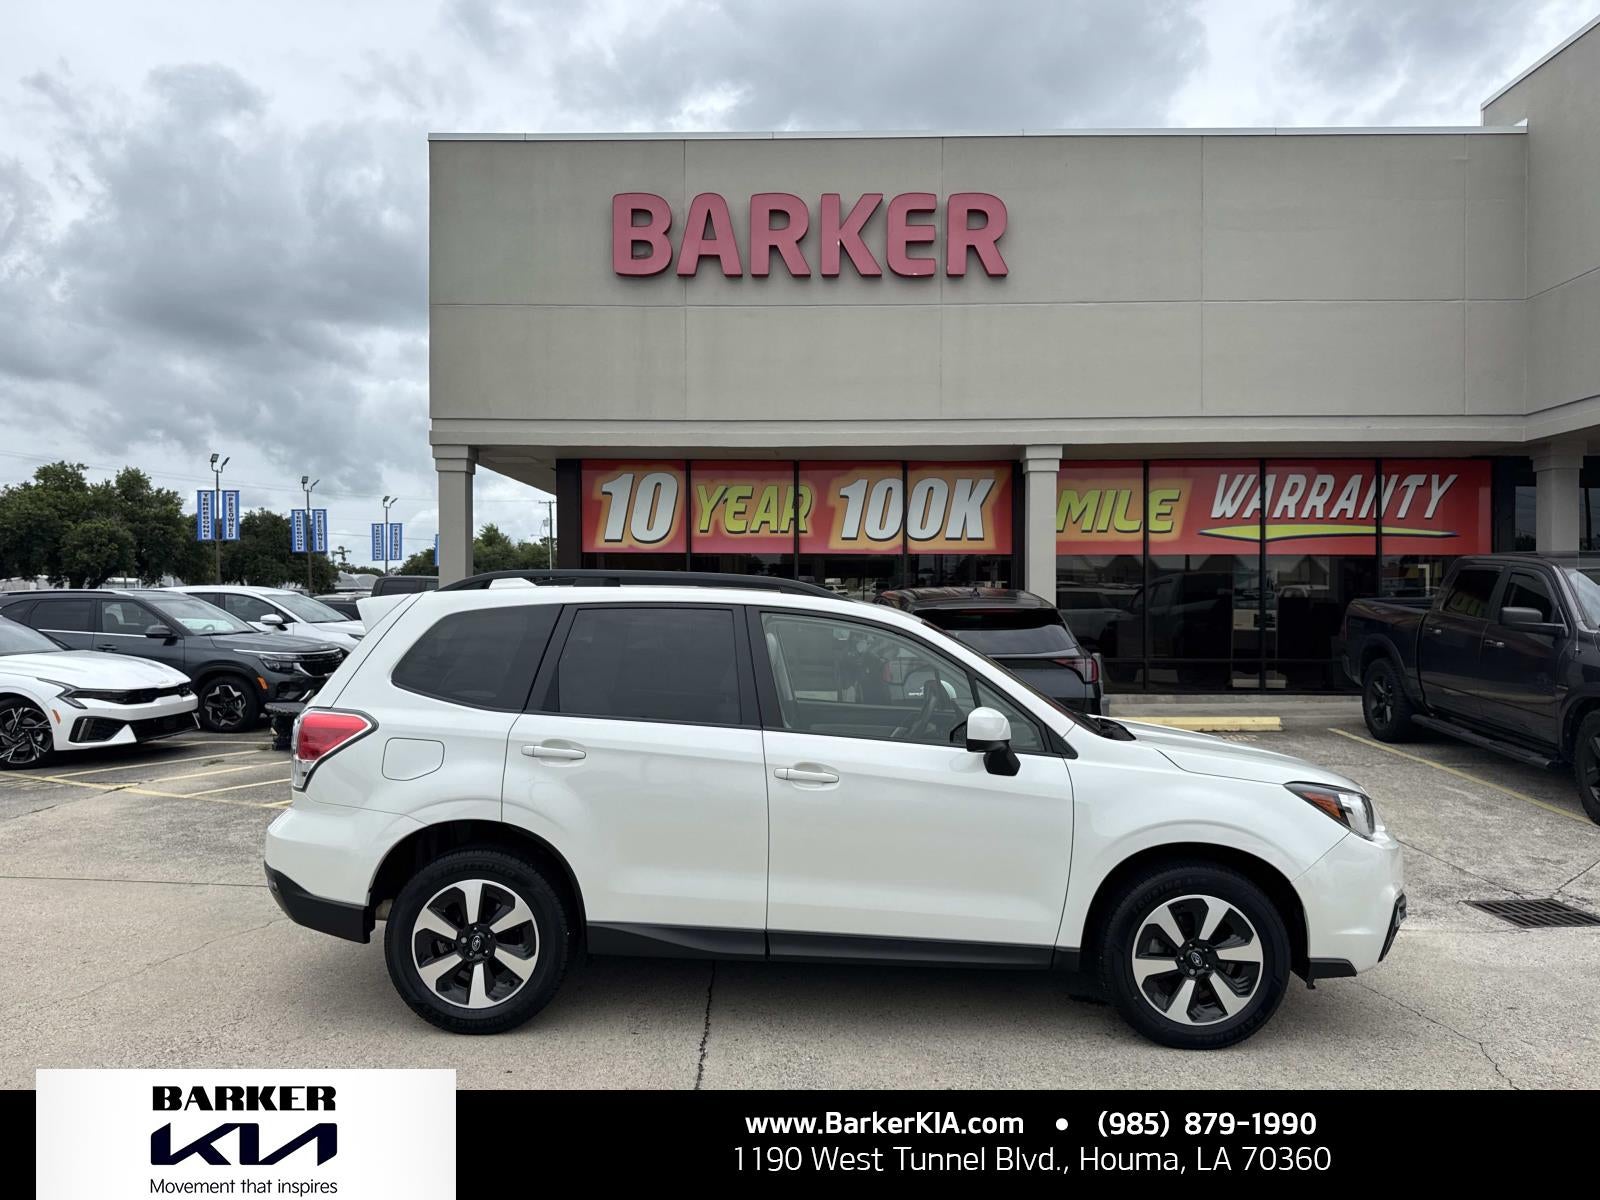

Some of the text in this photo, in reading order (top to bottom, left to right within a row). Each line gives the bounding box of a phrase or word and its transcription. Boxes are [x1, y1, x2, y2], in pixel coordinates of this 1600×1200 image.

[612, 192, 1009, 278] BARKER
[602, 472, 1458, 544] 10 YEAR 100K MILE WARRANTY
